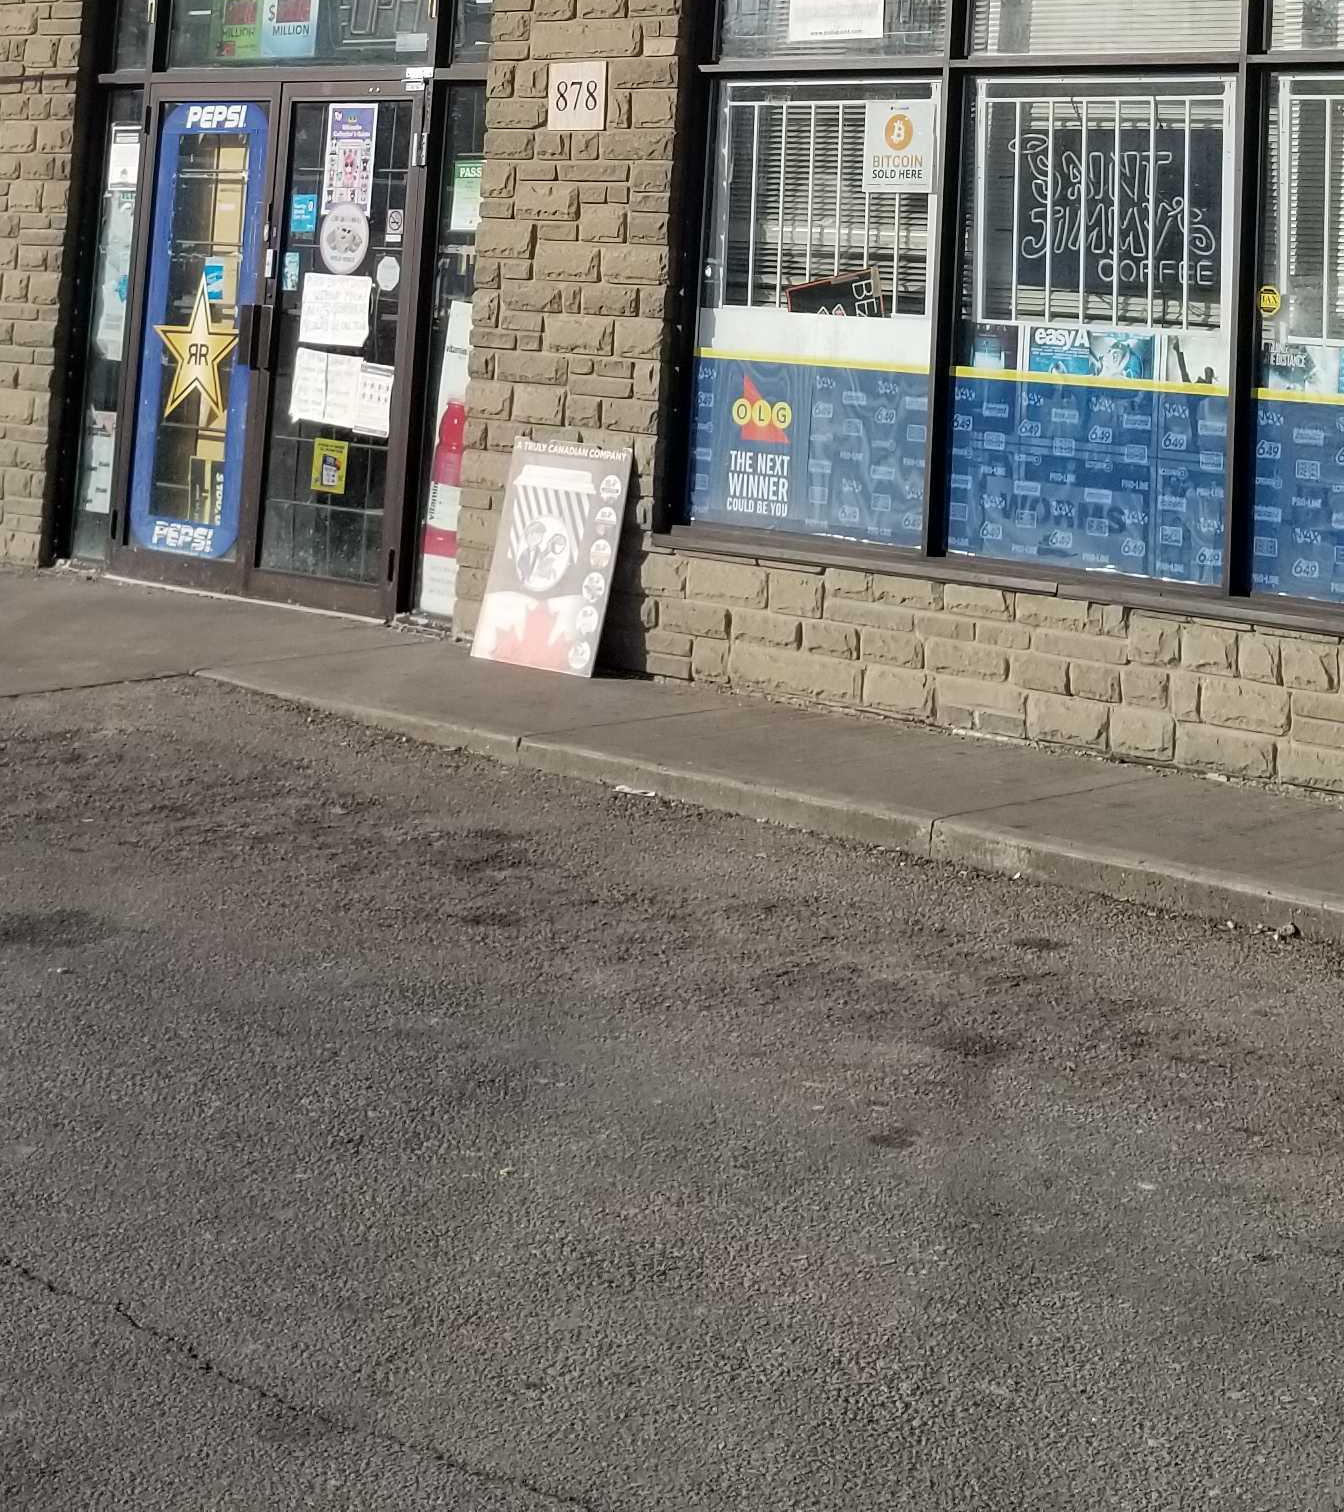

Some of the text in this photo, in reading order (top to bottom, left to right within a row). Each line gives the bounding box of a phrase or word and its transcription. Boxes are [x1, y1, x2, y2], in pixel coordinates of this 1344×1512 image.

[272, 24, 310, 37] MILLION
[555, 80, 598, 112] 878
[186, 104, 247, 129] PEPSI
[872, 155, 923, 168] BITCOIN
[459, 167, 483, 178] PASS
[872, 169, 923, 179] SOLD HERE
[1098, 259, 1214, 285] COFFEE
[734, 399, 791, 427] OLG
[1089, 425, 1113, 443] 649
[1162, 431, 1187, 450] 649
[524, 441, 548, 452] TRULY
[548, 444, 589, 457] CANADIAN
[589, 448, 627, 462] COMPANY
[729, 450, 791, 476] THE NEXT
[728, 472, 788, 502] WINNER
[726, 497, 788, 518] COULD BE YOU
[152, 520, 214, 553] PEPSI
